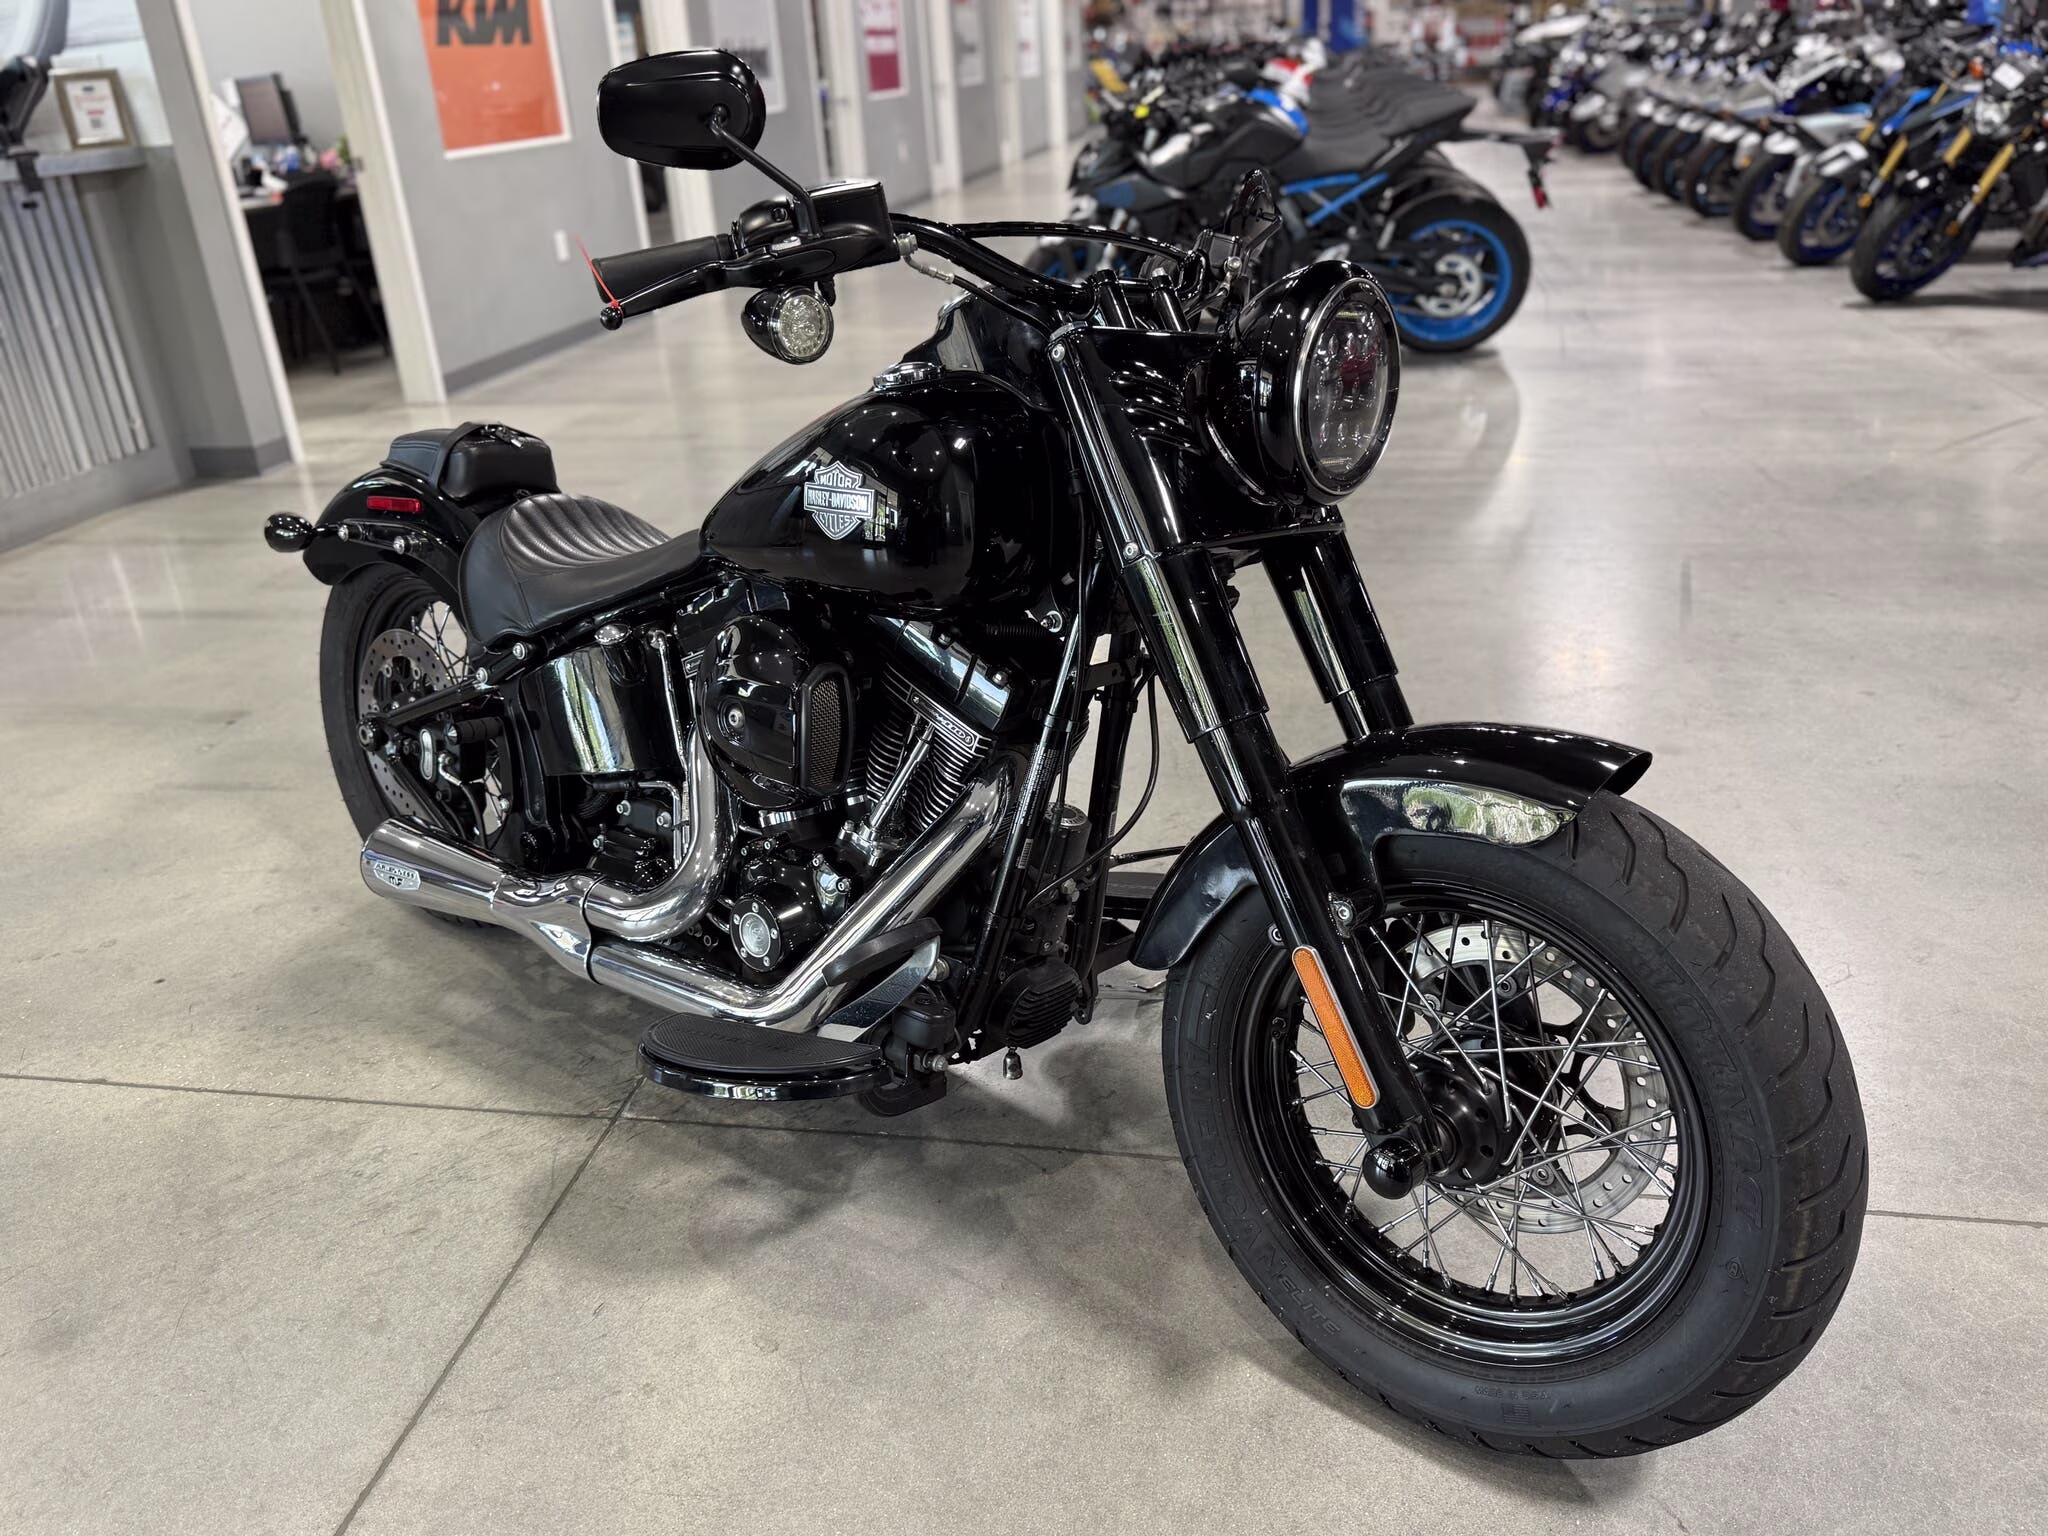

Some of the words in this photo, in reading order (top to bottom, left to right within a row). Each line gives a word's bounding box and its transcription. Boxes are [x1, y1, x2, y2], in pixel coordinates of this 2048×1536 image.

[436, 0, 532, 45] KTM
[819, 468, 852, 488] MOTOR
[807, 489, 868, 511] HARLEY-DAVIDSON
[1278, 1275, 1341, 1336] ELITE
